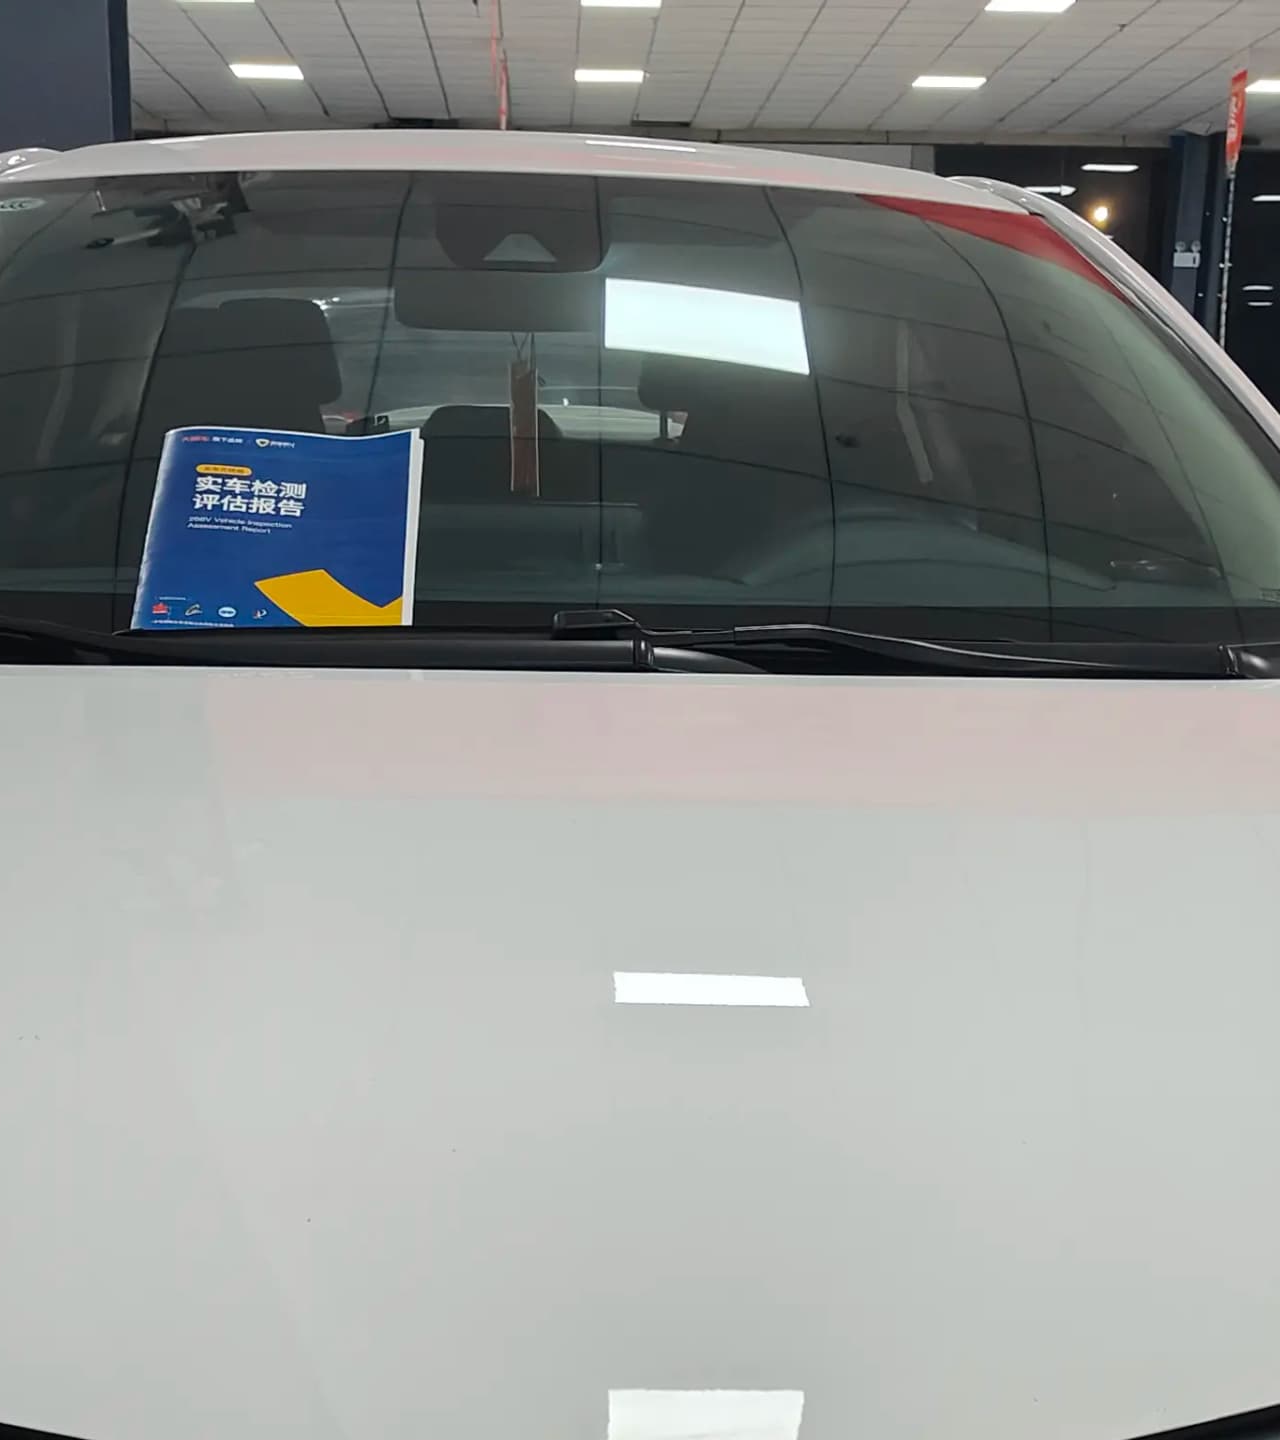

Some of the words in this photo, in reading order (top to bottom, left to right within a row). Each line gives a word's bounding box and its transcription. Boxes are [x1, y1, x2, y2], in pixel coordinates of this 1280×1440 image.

[195, 476, 307, 499] 实车检测
[192, 493, 305, 517] 评估报告
[187, 522, 239, 532] Assessment
[241, 526, 271, 535] Report
[214, 517, 246, 525] Vehicle
[247, 520, 293, 529] Inspection
